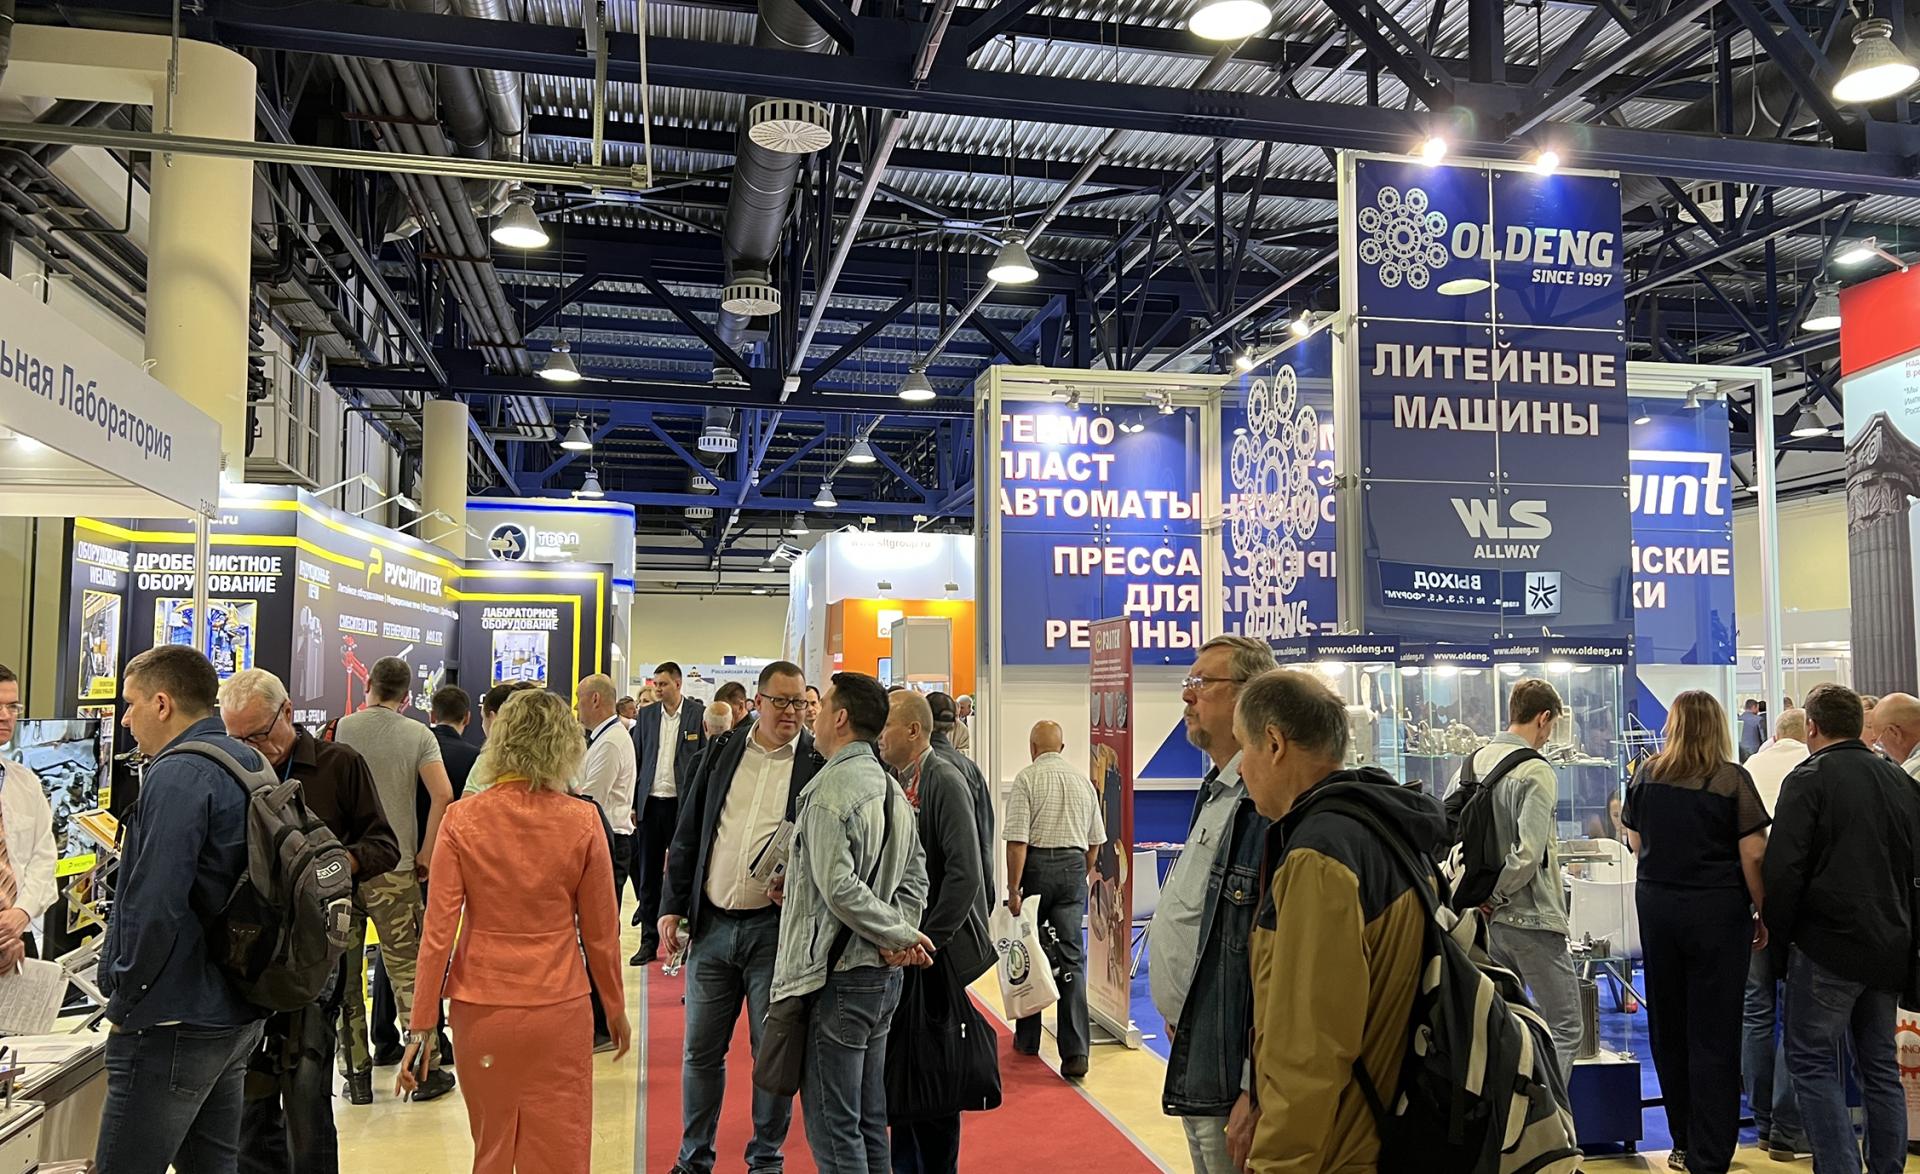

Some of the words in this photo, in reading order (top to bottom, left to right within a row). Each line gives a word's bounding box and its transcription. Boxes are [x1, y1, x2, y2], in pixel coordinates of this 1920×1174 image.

[1452, 222, 1614, 268] OLDENG
[1531, 269, 1574, 285] SINCE
[1578, 272, 1613, 288] 1997
[1372, 342, 1616, 387] ЛИТЕЙНЫЕ
[0, 339, 54, 401] ьная
[59, 364, 172, 462] Лаборатория
[1394, 395, 1599, 436] МАШИНЫ
[1450, 498, 1552, 540] WLS
[1053, 546, 1200, 577] ПРЕССА
[1473, 545, 1541, 559] ALLWAY
[138, 573, 276, 593] ОБОРУОВАНИЕ
[383, 562, 442, 597] РУСЛИТТЕХ
[1124, 583, 1199, 617] ДЛЯ
[481, 619, 558, 630] ОБОРУДОВАНИЕ
[482, 607, 558, 618] ЛАБОРАТОРНОЕ
[1046, 619, 1200, 648] РЕНЫ
[1318, 645, 1394, 655] www.oldeng.ru
[1434, 652, 1489, 661] www.oldeng.
[1493, 645, 1540, 657] www.oldeng.ru
[1552, 645, 1623, 657] www.oldeng.ru
